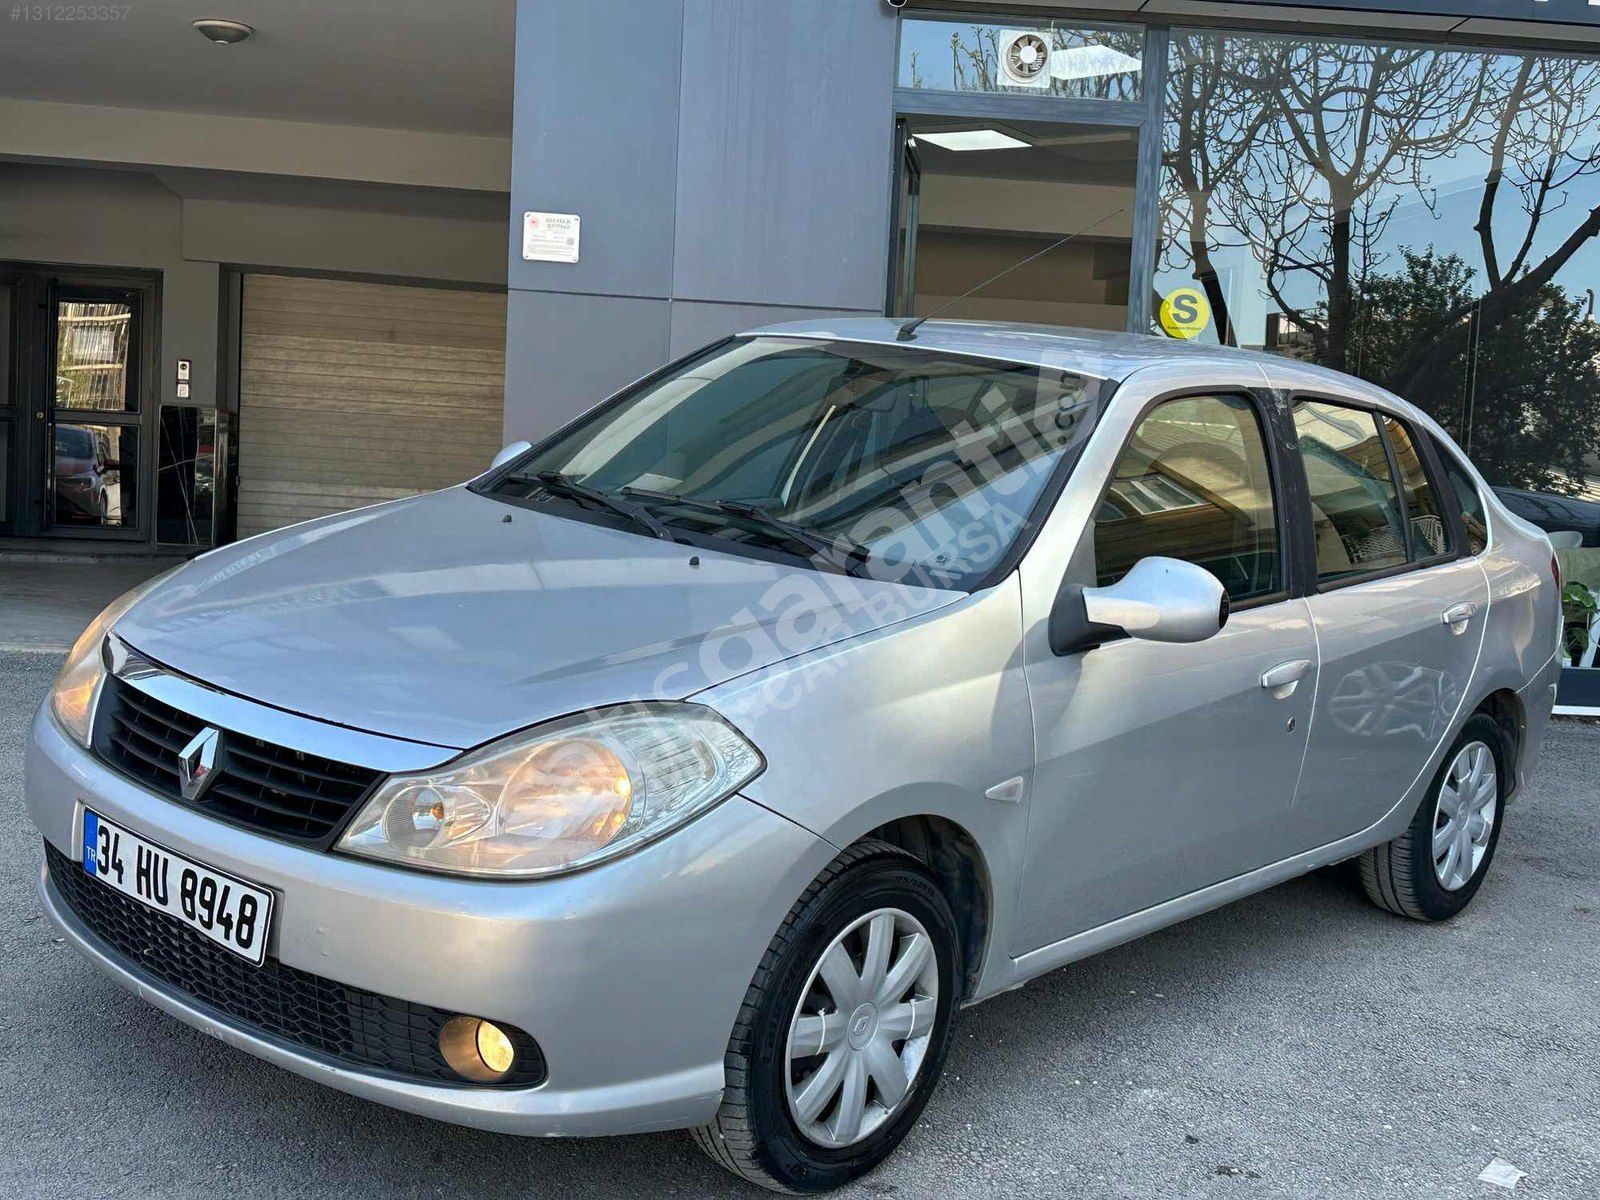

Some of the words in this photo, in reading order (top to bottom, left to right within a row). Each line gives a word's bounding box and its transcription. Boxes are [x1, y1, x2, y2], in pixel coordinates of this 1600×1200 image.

[1172, 294, 1198, 324] S
[86, 846, 96, 862] TR
[97, 825, 124, 885] 34
[136, 845, 169, 906] HU
[180, 868, 258, 950] 8948
